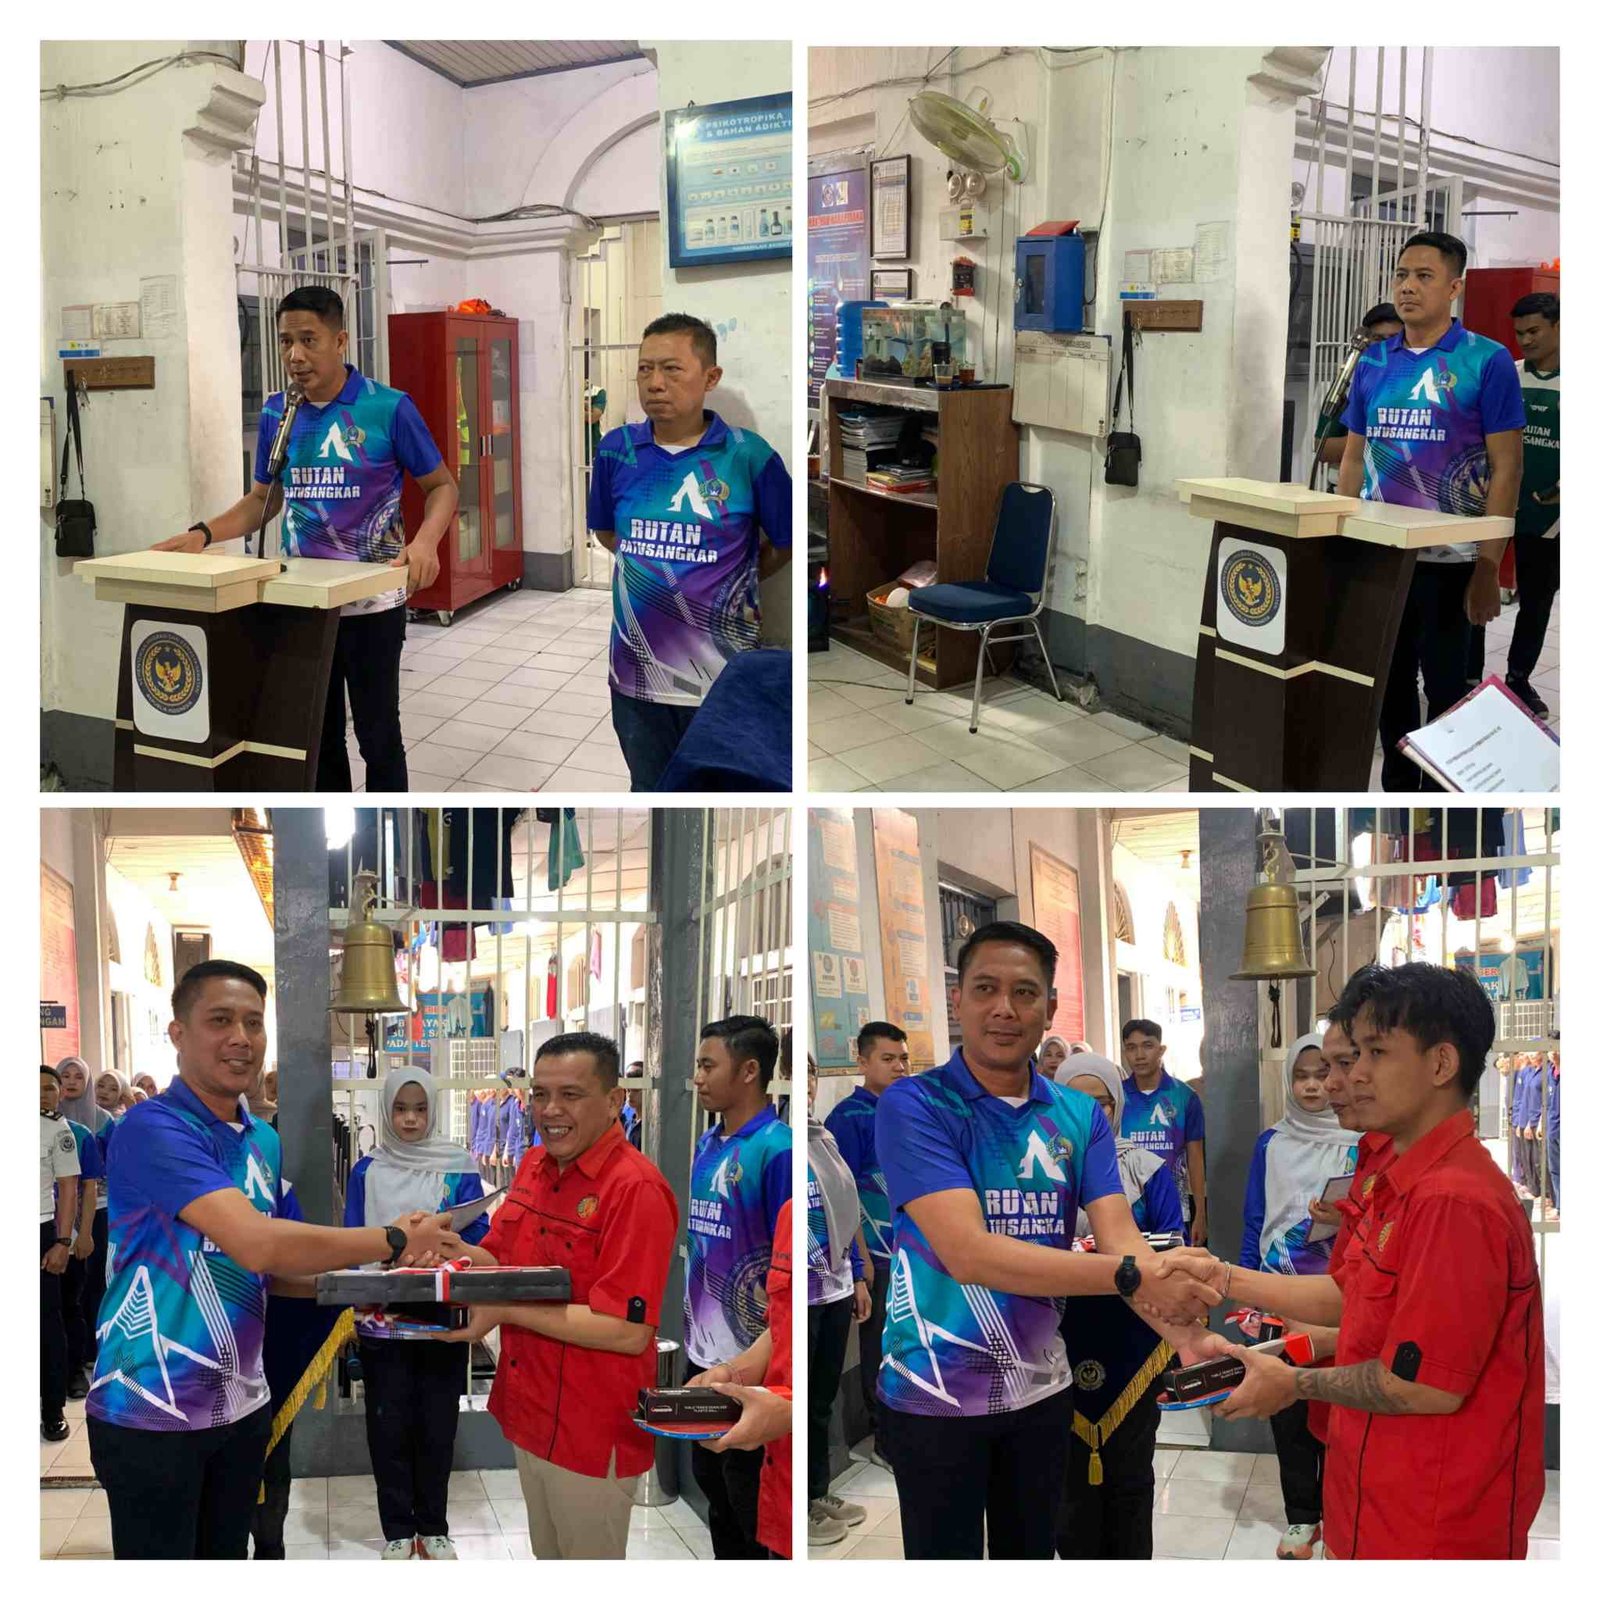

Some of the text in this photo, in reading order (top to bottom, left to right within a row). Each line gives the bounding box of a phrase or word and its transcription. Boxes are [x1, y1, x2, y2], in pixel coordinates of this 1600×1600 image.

[705, 112, 783, 130] PSIKOTROPIKA
[716, 125, 752, 137] BAHAN
[1377, 407, 1432, 426] RUTAN
[290, 466, 345, 484] RUTAN
[630, 518, 702, 546] RUTAN
[619, 538, 718, 563] BATUSANGKAR
[1129, 1130, 1167, 1142] RUTAN
